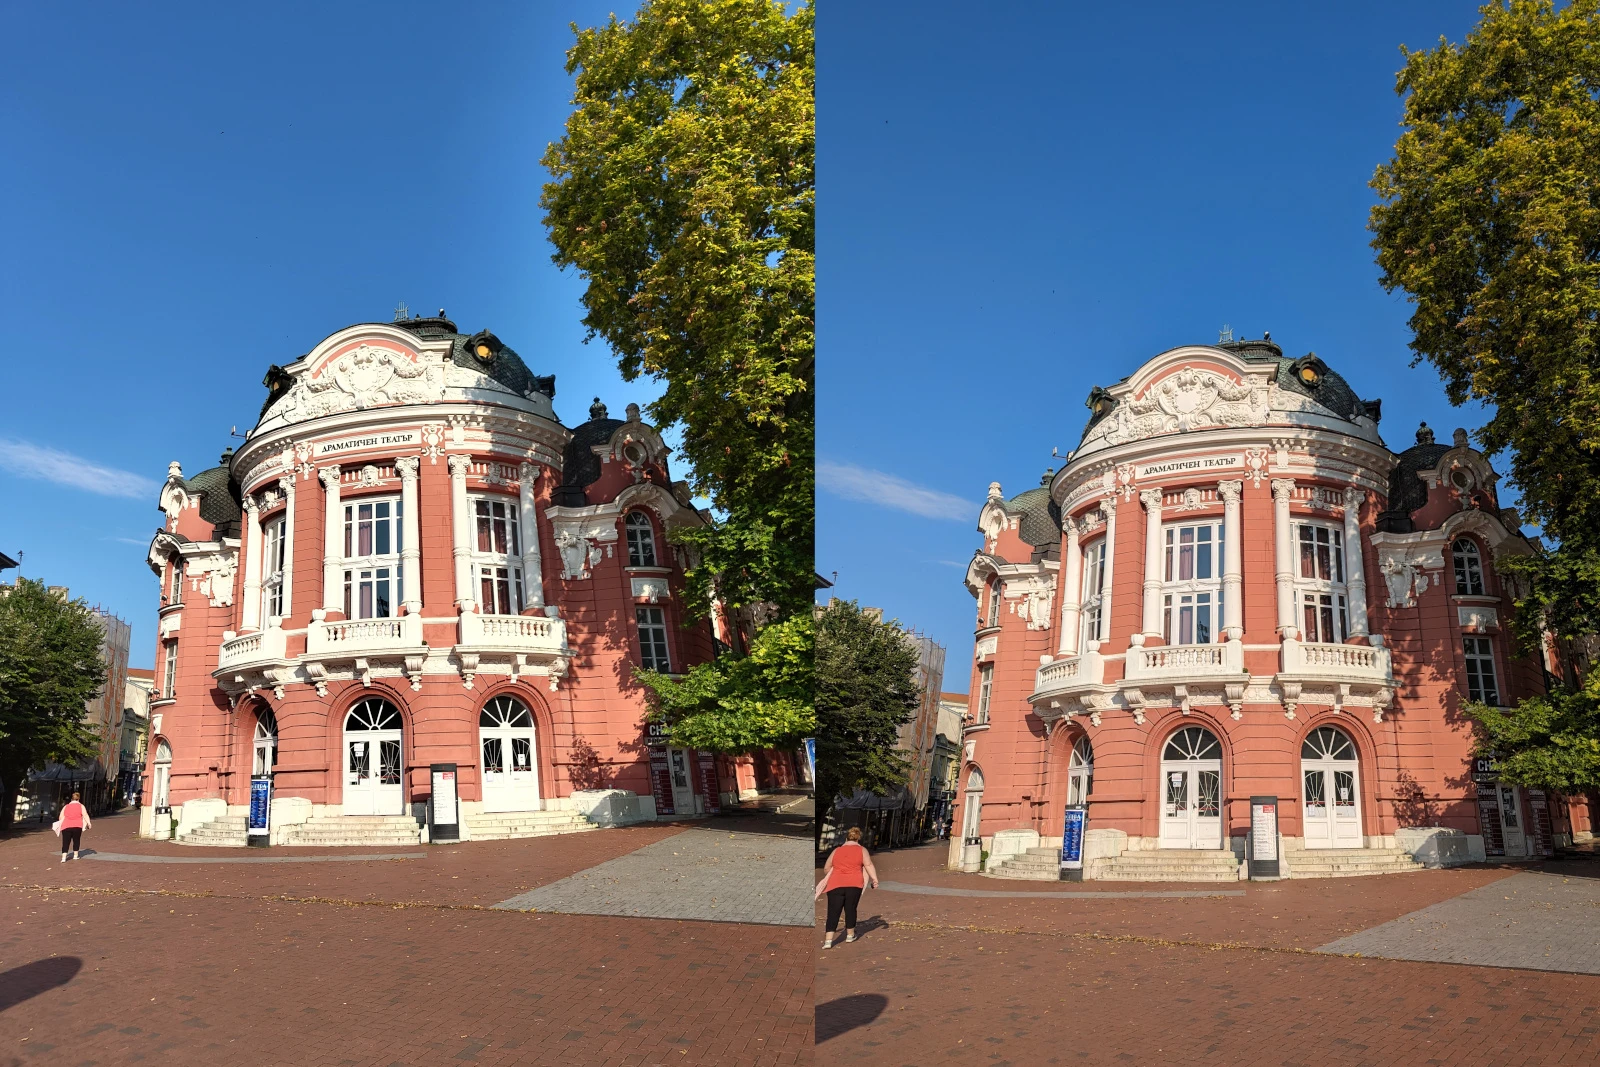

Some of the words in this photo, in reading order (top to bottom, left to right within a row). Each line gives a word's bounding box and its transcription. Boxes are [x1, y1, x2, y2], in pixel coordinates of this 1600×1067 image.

[321, 437, 378, 453] ДРАМАТИЧЕН
[381, 434, 413, 444] ТЕАТЪР
[1143, 460, 1201, 476] ДРАМАТИЧЕН
[1204, 457, 1236, 467] ТЕАТЪР
